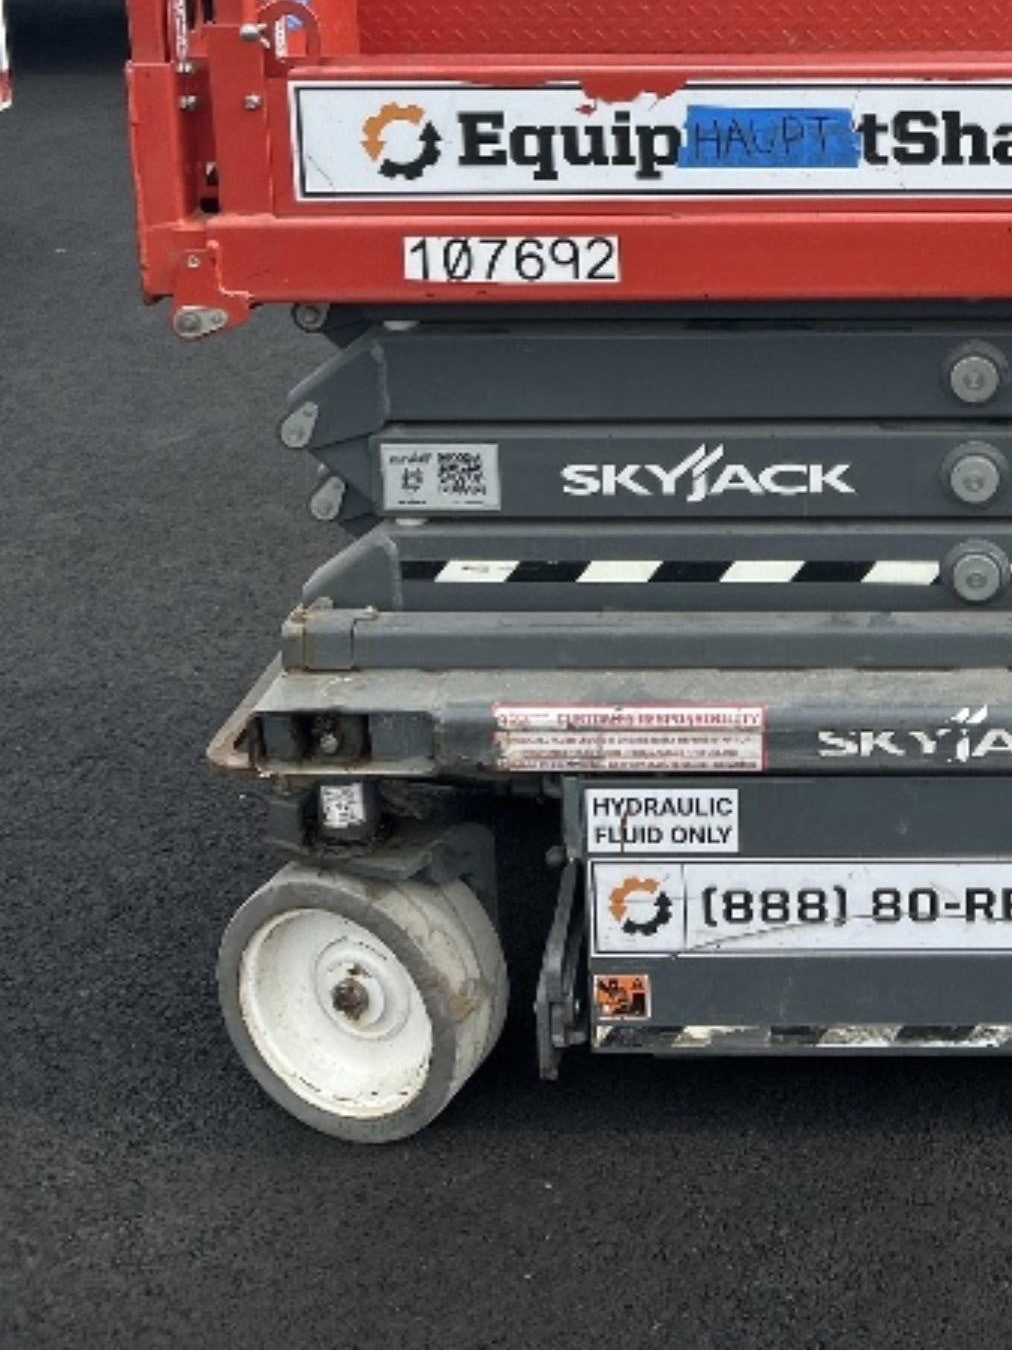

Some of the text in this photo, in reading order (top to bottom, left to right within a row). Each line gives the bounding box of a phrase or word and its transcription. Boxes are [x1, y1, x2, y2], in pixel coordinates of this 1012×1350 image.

[409, 237, 617, 282] 107692
[560, 444, 857, 502] SKYJACK
[593, 797, 733, 817] HYDRAULIC
[595, 826, 733, 844] FLUID ONLY
[701, 887, 847, 927] (888)
